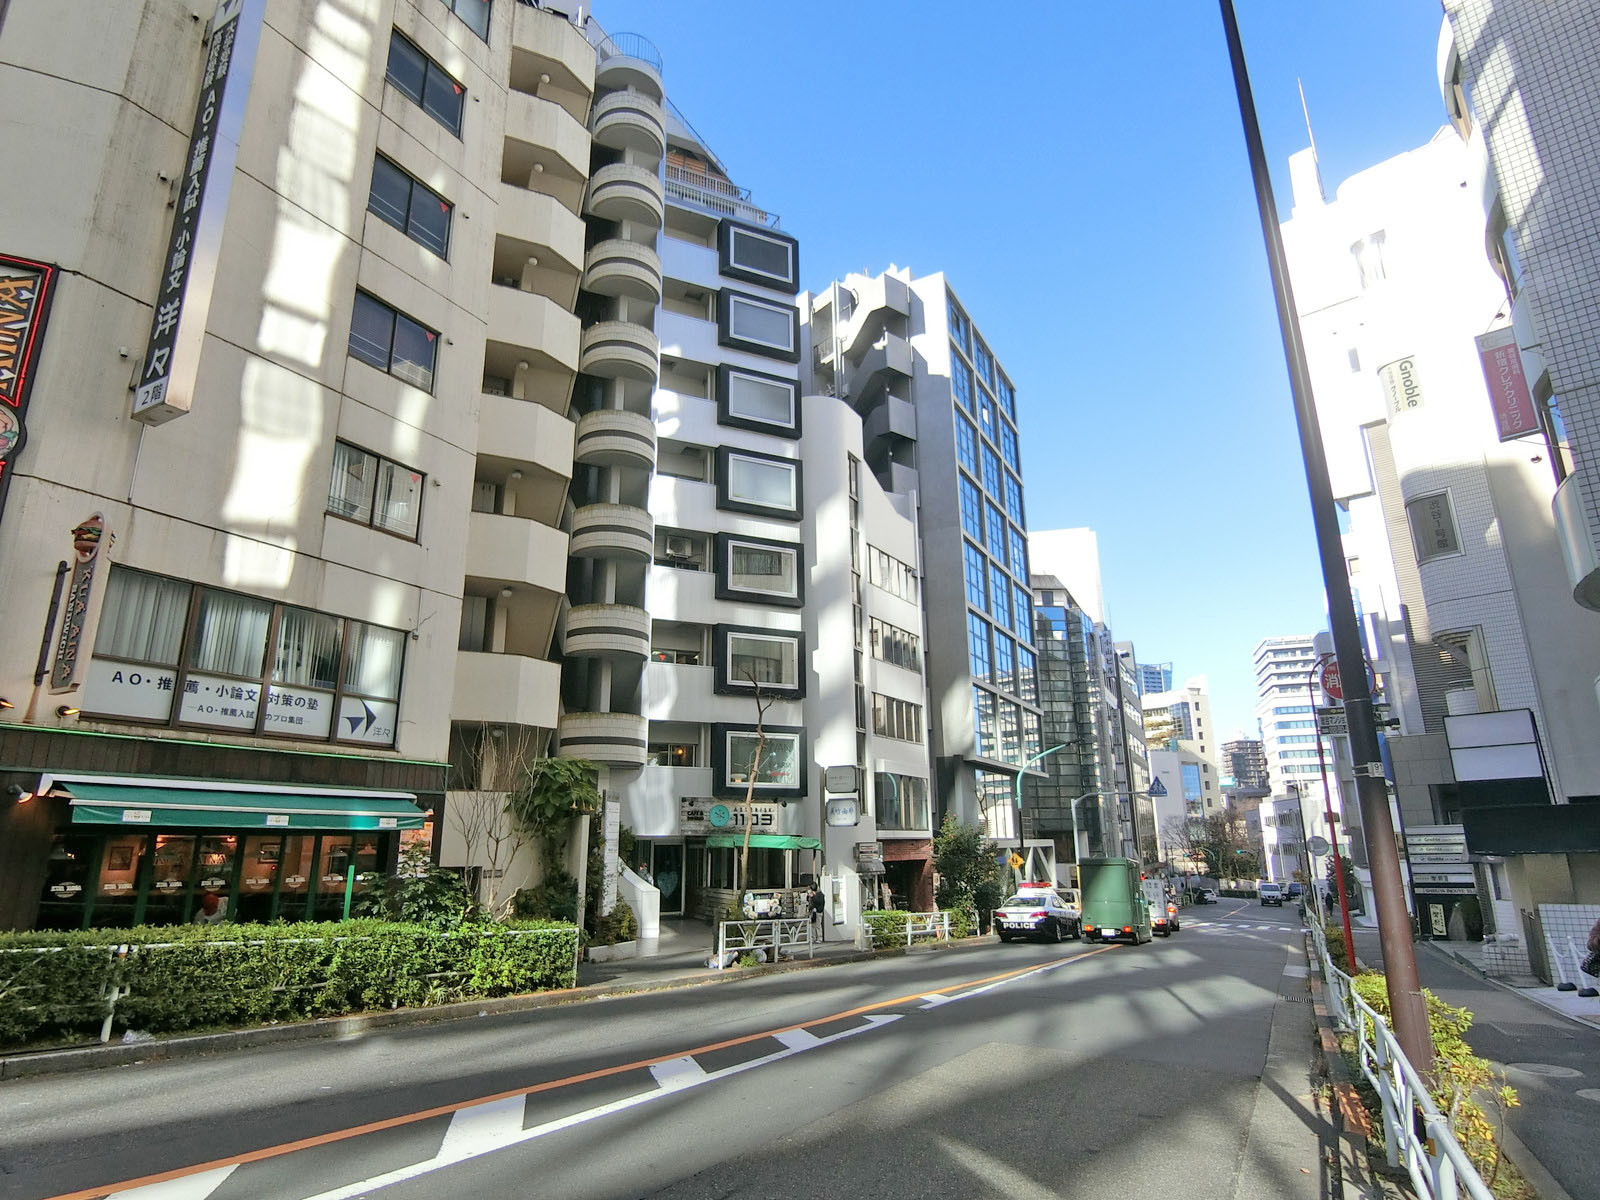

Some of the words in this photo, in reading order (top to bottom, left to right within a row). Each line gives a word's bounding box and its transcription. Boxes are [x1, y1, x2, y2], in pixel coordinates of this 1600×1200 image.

[146, 297, 181, 379] 洋々
[141, 383, 163, 405] 2階
[1400, 360, 1420, 407] Gnoble
[62, 623, 81, 681] AINA
[372, 726, 392, 738] 洋々
[733, 813, 773, 826] 1103
[1003, 921, 1037, 930] POLICE
